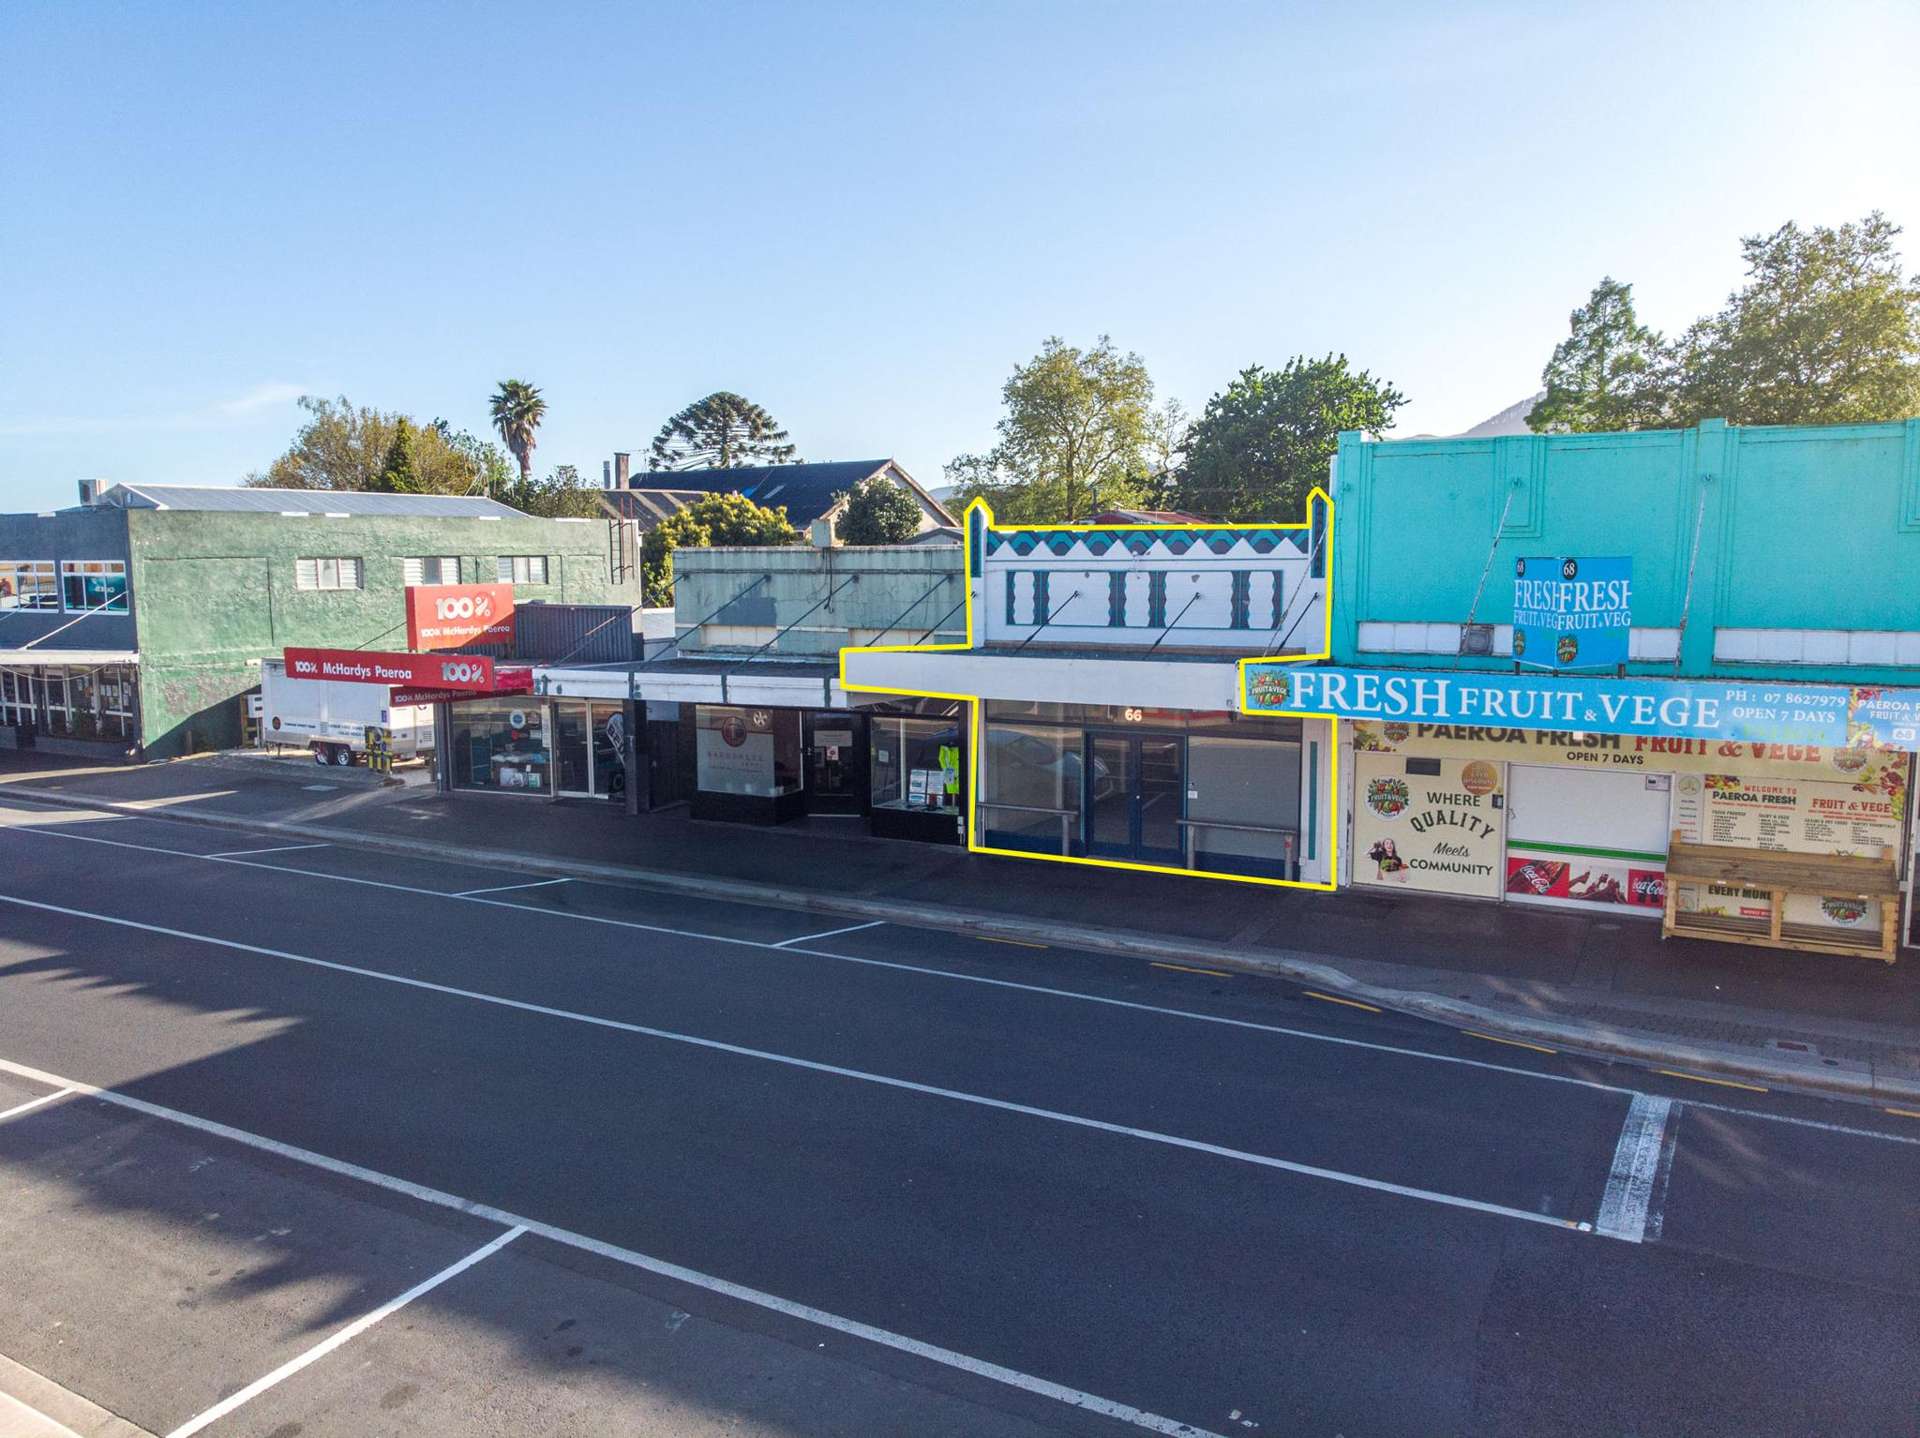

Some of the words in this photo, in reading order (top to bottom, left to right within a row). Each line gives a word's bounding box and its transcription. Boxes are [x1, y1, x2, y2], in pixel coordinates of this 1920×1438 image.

[1563, 562, 1576, 576] 68
[435, 596, 491, 620] 100%
[443, 626, 480, 637] McHardys
[482, 624, 510, 634] Paeroa
[1558, 613, 1600, 630] FRUIT
[295, 660, 318, 673] 100%
[322, 663, 371, 678] McHardys
[375, 664, 412, 680] Paeroa
[441, 662, 485, 684] 100%
[1290, 671, 1451, 717] FRESH
[1458, 687, 1583, 721] FRUIT
[1584, 709, 1597, 722] &
[1598, 693, 1720, 729] VEGE
[1725, 689, 1747, 702] PH
[1764, 693, 1780, 703] 07
[1785, 693, 1846, 708] 8627979
[1858, 699, 1911, 712] PAEROA
[1124, 707, 1142, 722] 66
[1732, 706, 1776, 720] OPEN
[1780, 710, 1789, 721] 7
[1793, 710, 1836, 724] DAYS
[1870, 711, 1900, 721] FRUIT
[1566, 751, 1598, 762] OPEN
[1602, 753, 1609, 763] 7
[1613, 754, 1644, 765] DAYS
[1718, 740, 1743, 758] &
[1751, 742, 1822, 762] VEGE
[1426, 791, 1481, 807] WHERE
[1712, 791, 1758, 803] PAEROA
[1762, 794, 1797, 806] FRESH
[1812, 798, 1846, 810] FRUIT
[1848, 802, 1859, 811] &
[1861, 801, 1892, 814] VEGE
[1410, 809, 1496, 840] QUALITY
[1433, 841, 1470, 858] Meets
[1409, 858, 1494, 876] COMMUNITY
